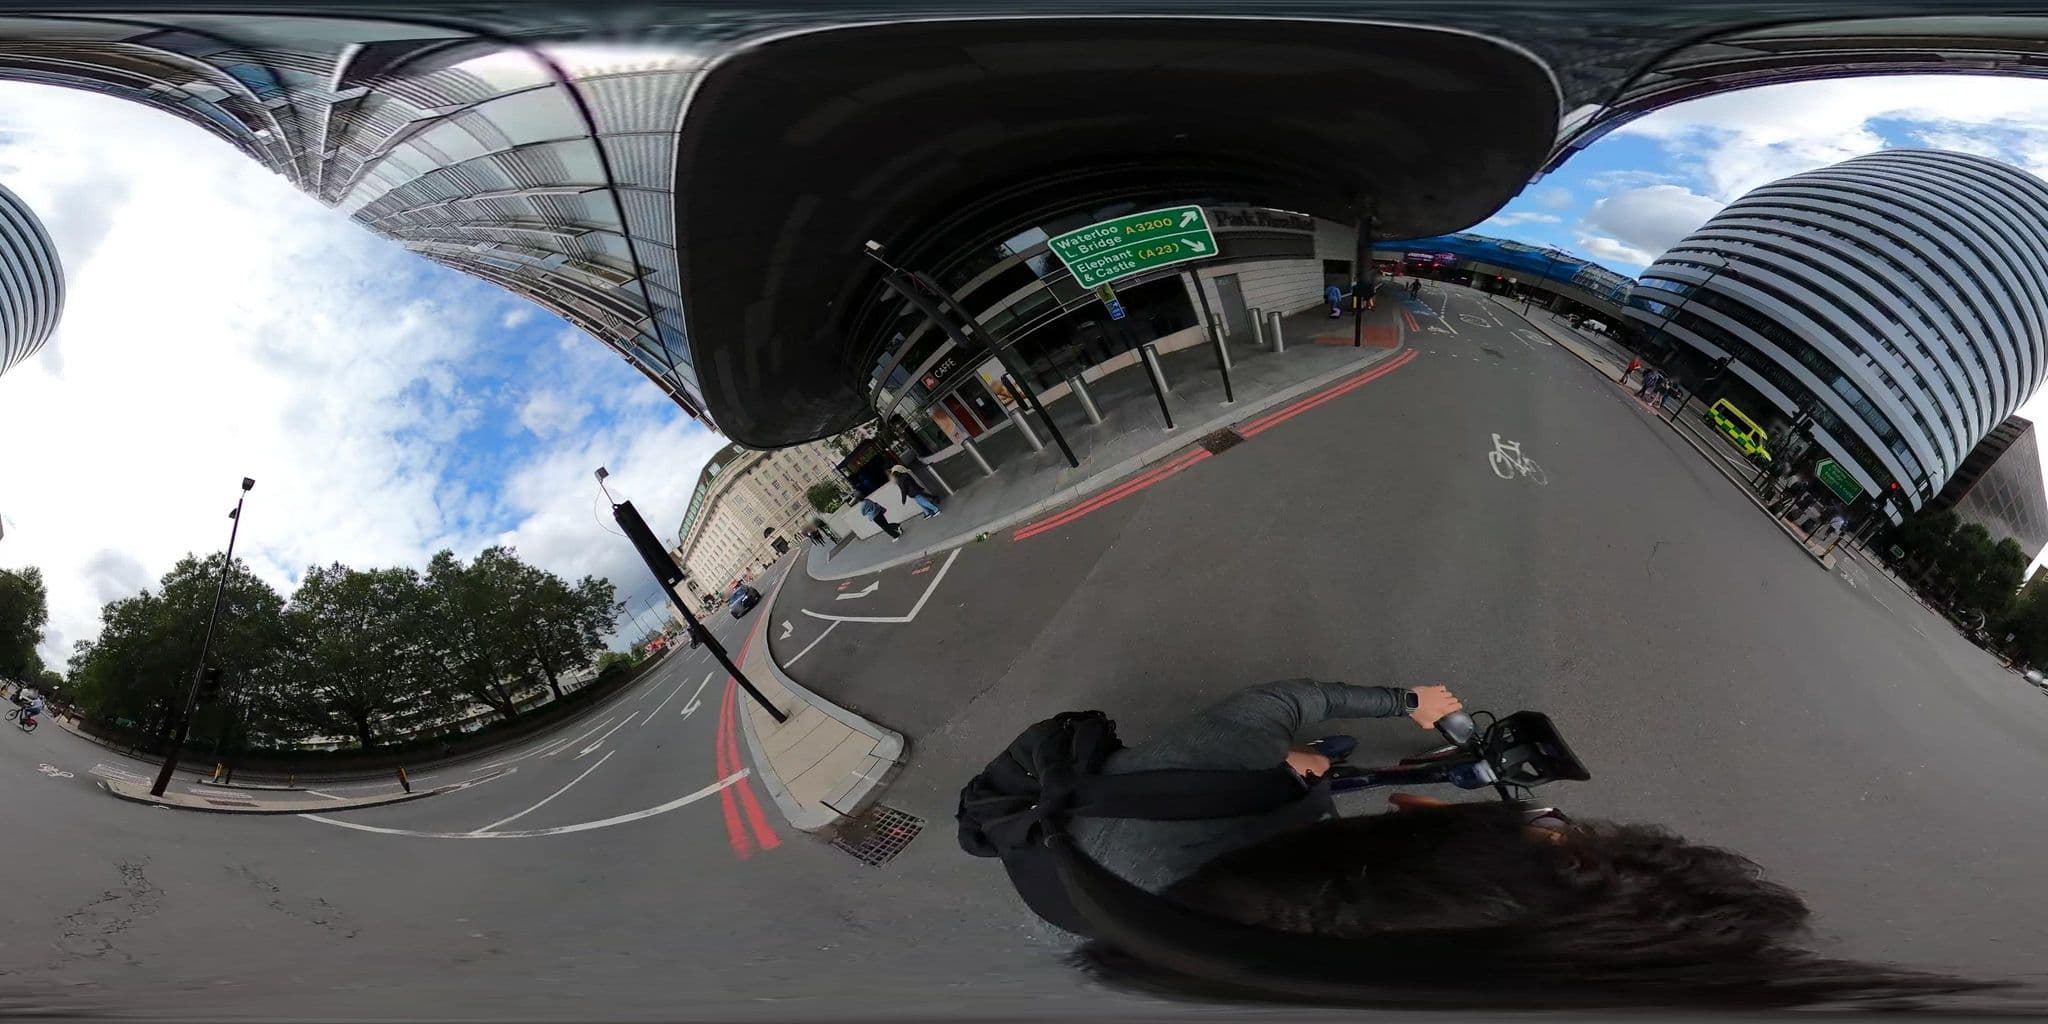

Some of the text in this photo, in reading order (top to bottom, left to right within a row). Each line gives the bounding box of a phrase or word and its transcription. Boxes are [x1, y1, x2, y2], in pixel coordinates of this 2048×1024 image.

[1057, 218, 1173, 249] Waterloo A3200
[1081, 235, 1122, 253] Bridge
[1077, 243, 1180, 273] Elephant (A23)
[1084, 261, 1136, 282] & Castle
